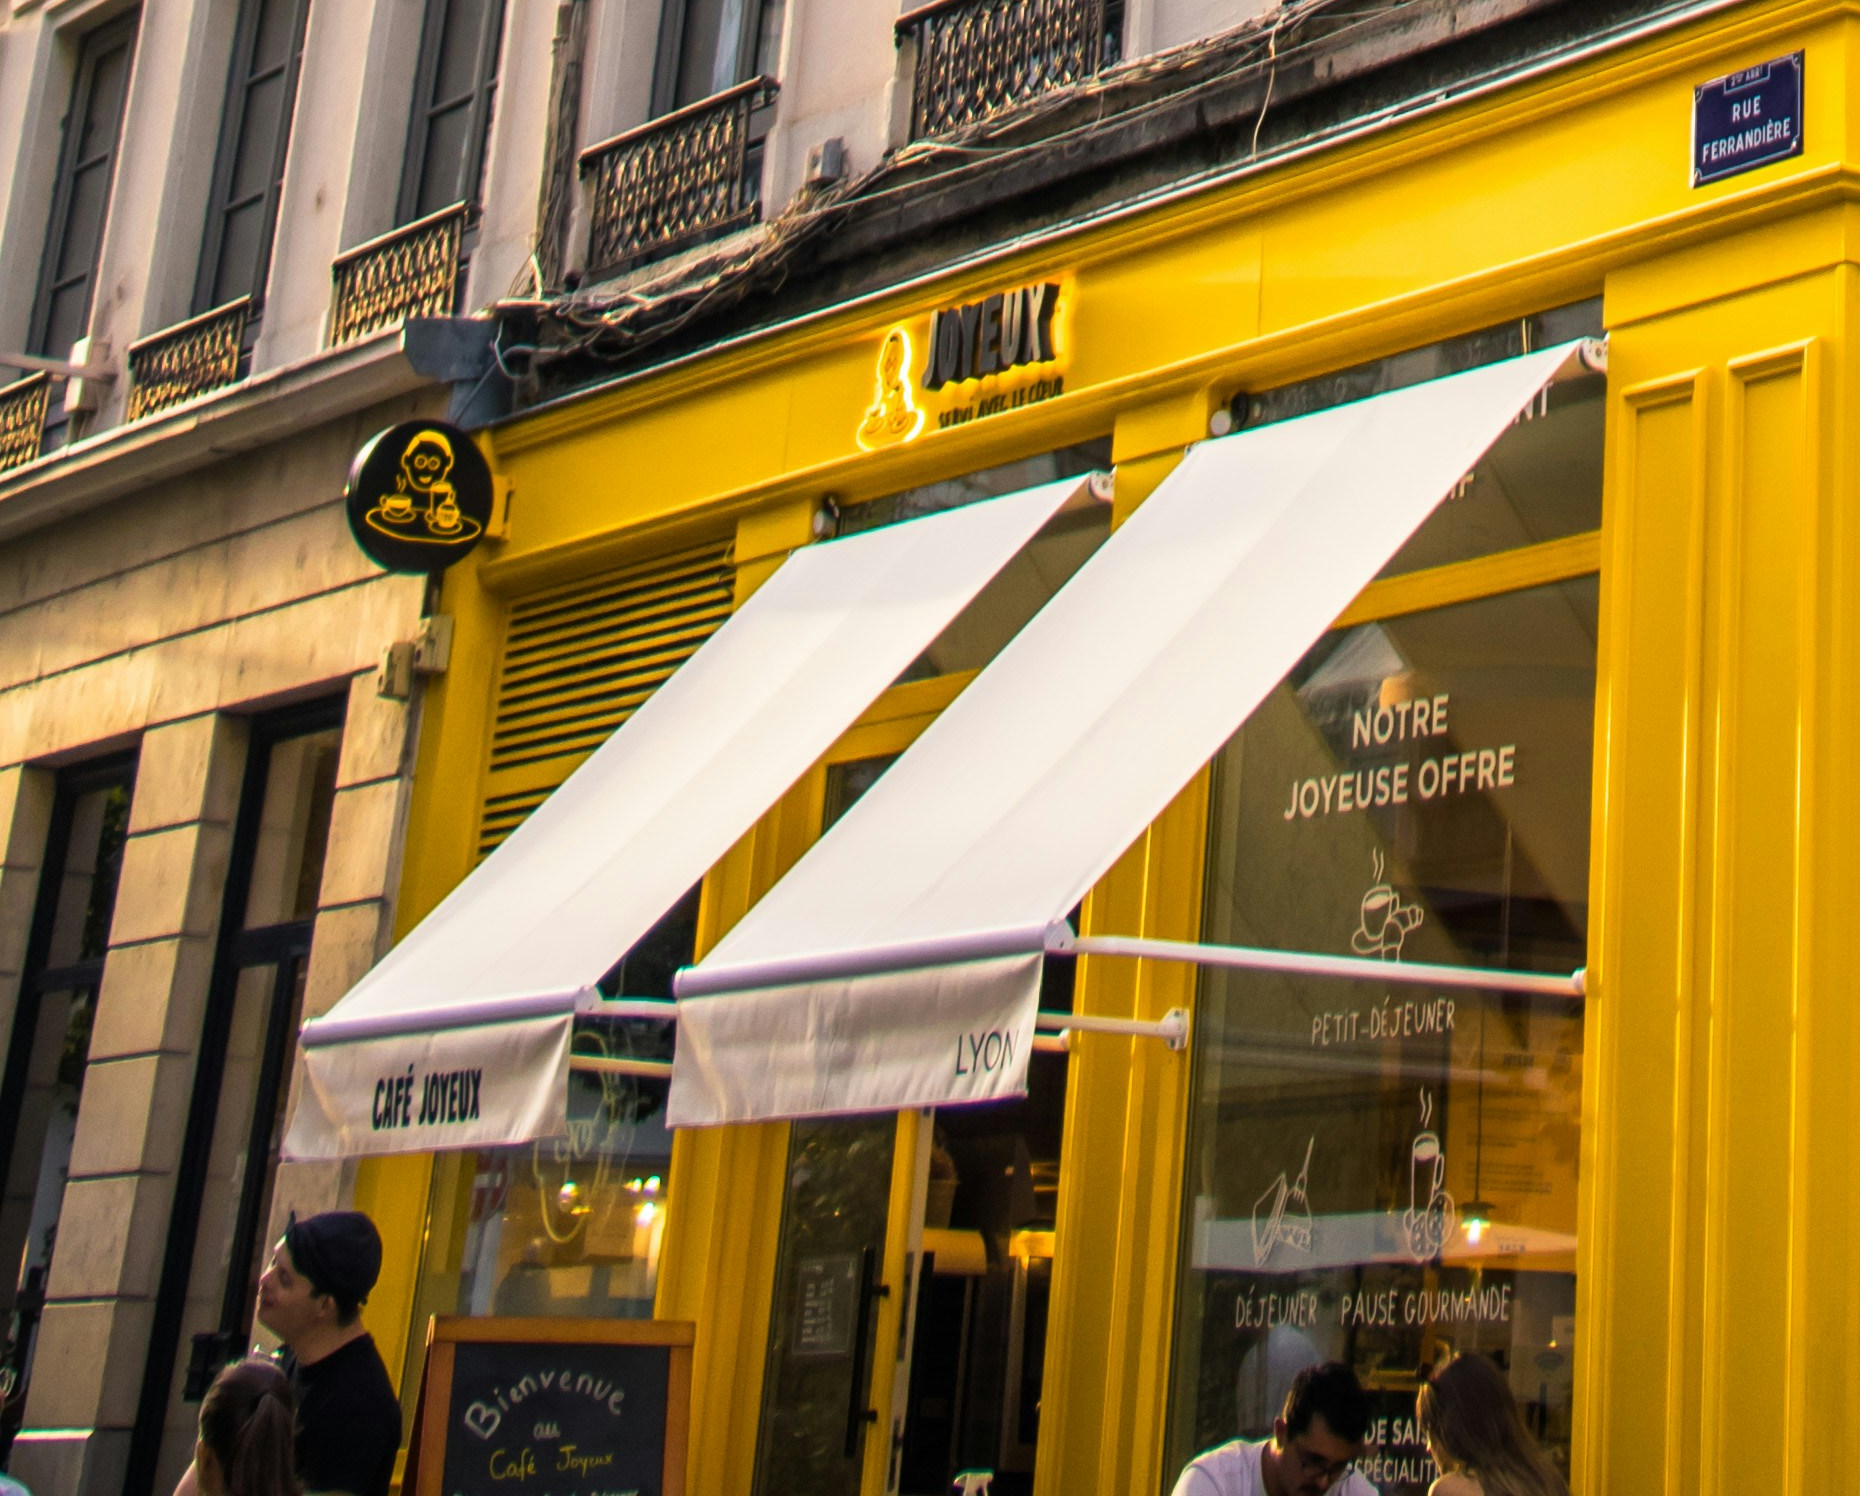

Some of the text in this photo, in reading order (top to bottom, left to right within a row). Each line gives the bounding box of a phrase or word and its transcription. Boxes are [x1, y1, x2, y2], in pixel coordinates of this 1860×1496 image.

[1732, 95, 1762, 123] RUE
[1702, 117, 1791, 164] FERRANDIÈRE
[921, 282, 1060, 392] JOYEUX
[1352, 694, 1449, 749] NOTRE
[1283, 744, 1516, 821] JOYEUSE OFFRE
[955, 1029, 1020, 1076] LYON
[372, 1063, 482, 1130] CAFÉ JOYEUX
[1234, 1285, 1317, 1329] DÉJEUNER
[1340, 1285, 1512, 1327] PAUSE GOURMANDE
[464, 1369, 626, 1441] Bienvenue
[533, 1421, 561, 1440] au
[489, 1444, 615, 1481] Café Joyeux
